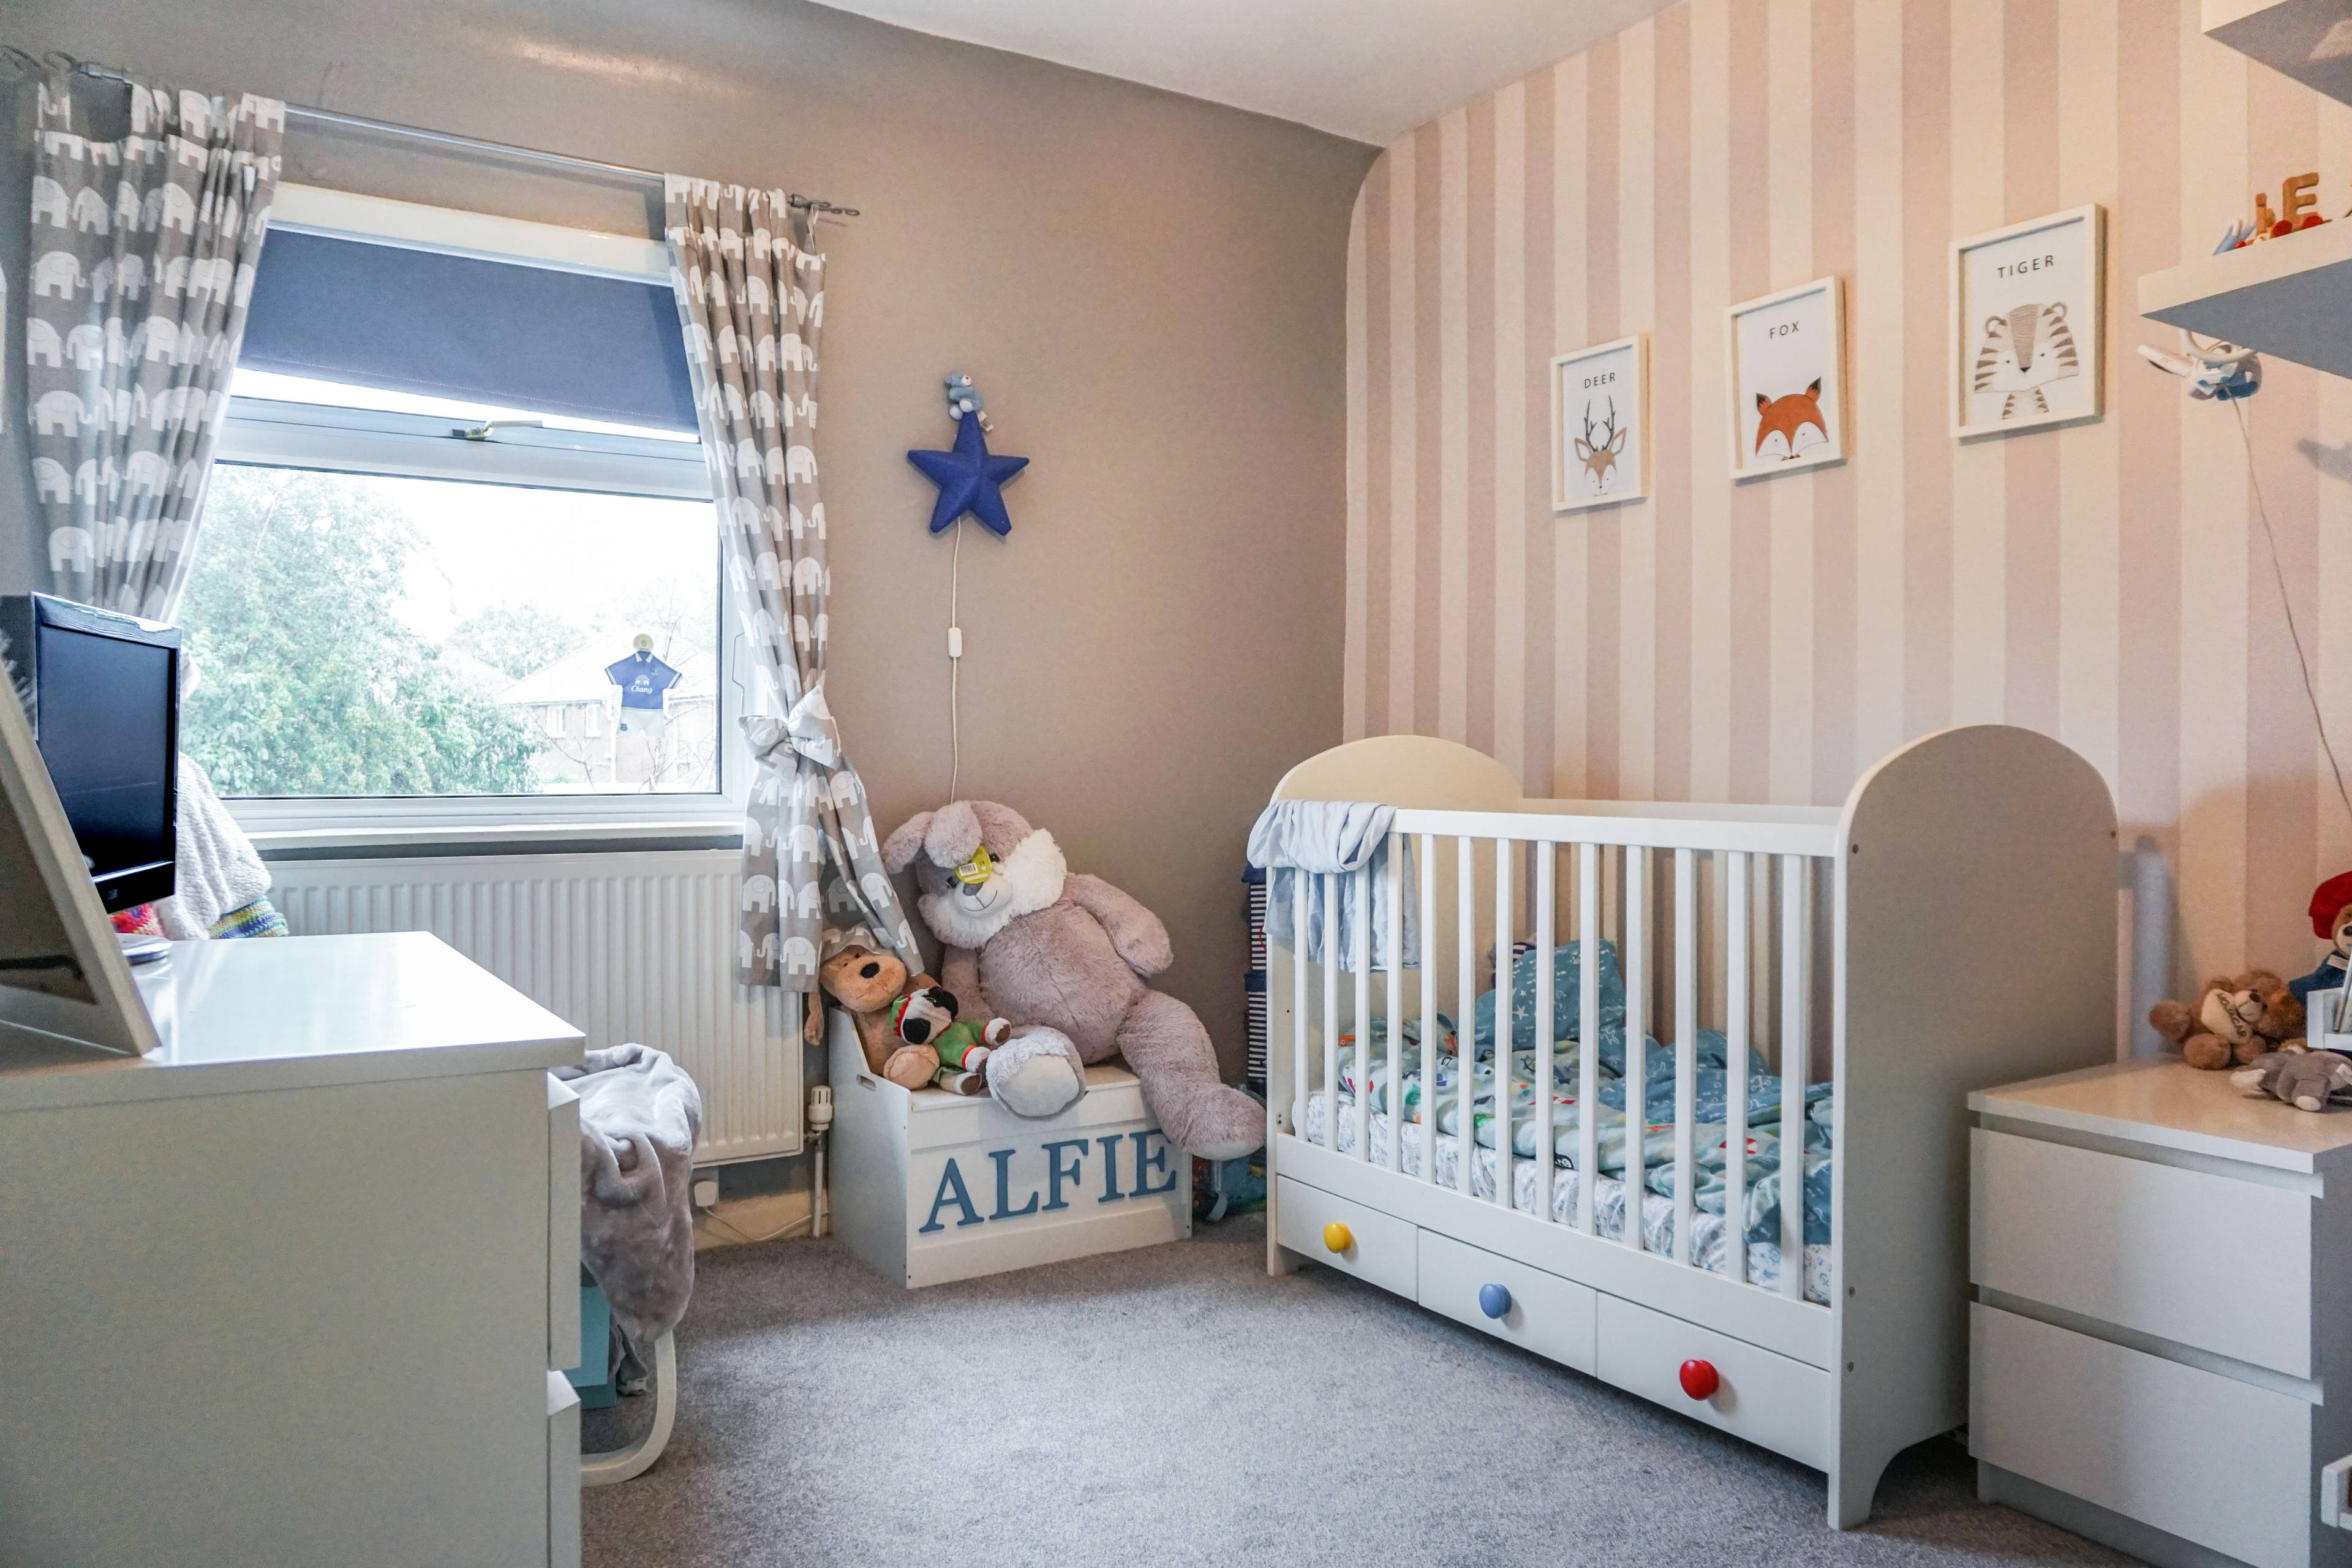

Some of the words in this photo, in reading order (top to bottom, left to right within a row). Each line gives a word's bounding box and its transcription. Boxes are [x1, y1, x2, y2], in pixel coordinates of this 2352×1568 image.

[1997, 255, 2054, 279] TIGER
[1770, 321, 1800, 339] FOX
[1584, 372, 1616, 388] DEER
[631, 685, 653, 695] Chang
[919, 1129, 1177, 1233] ALFIE
